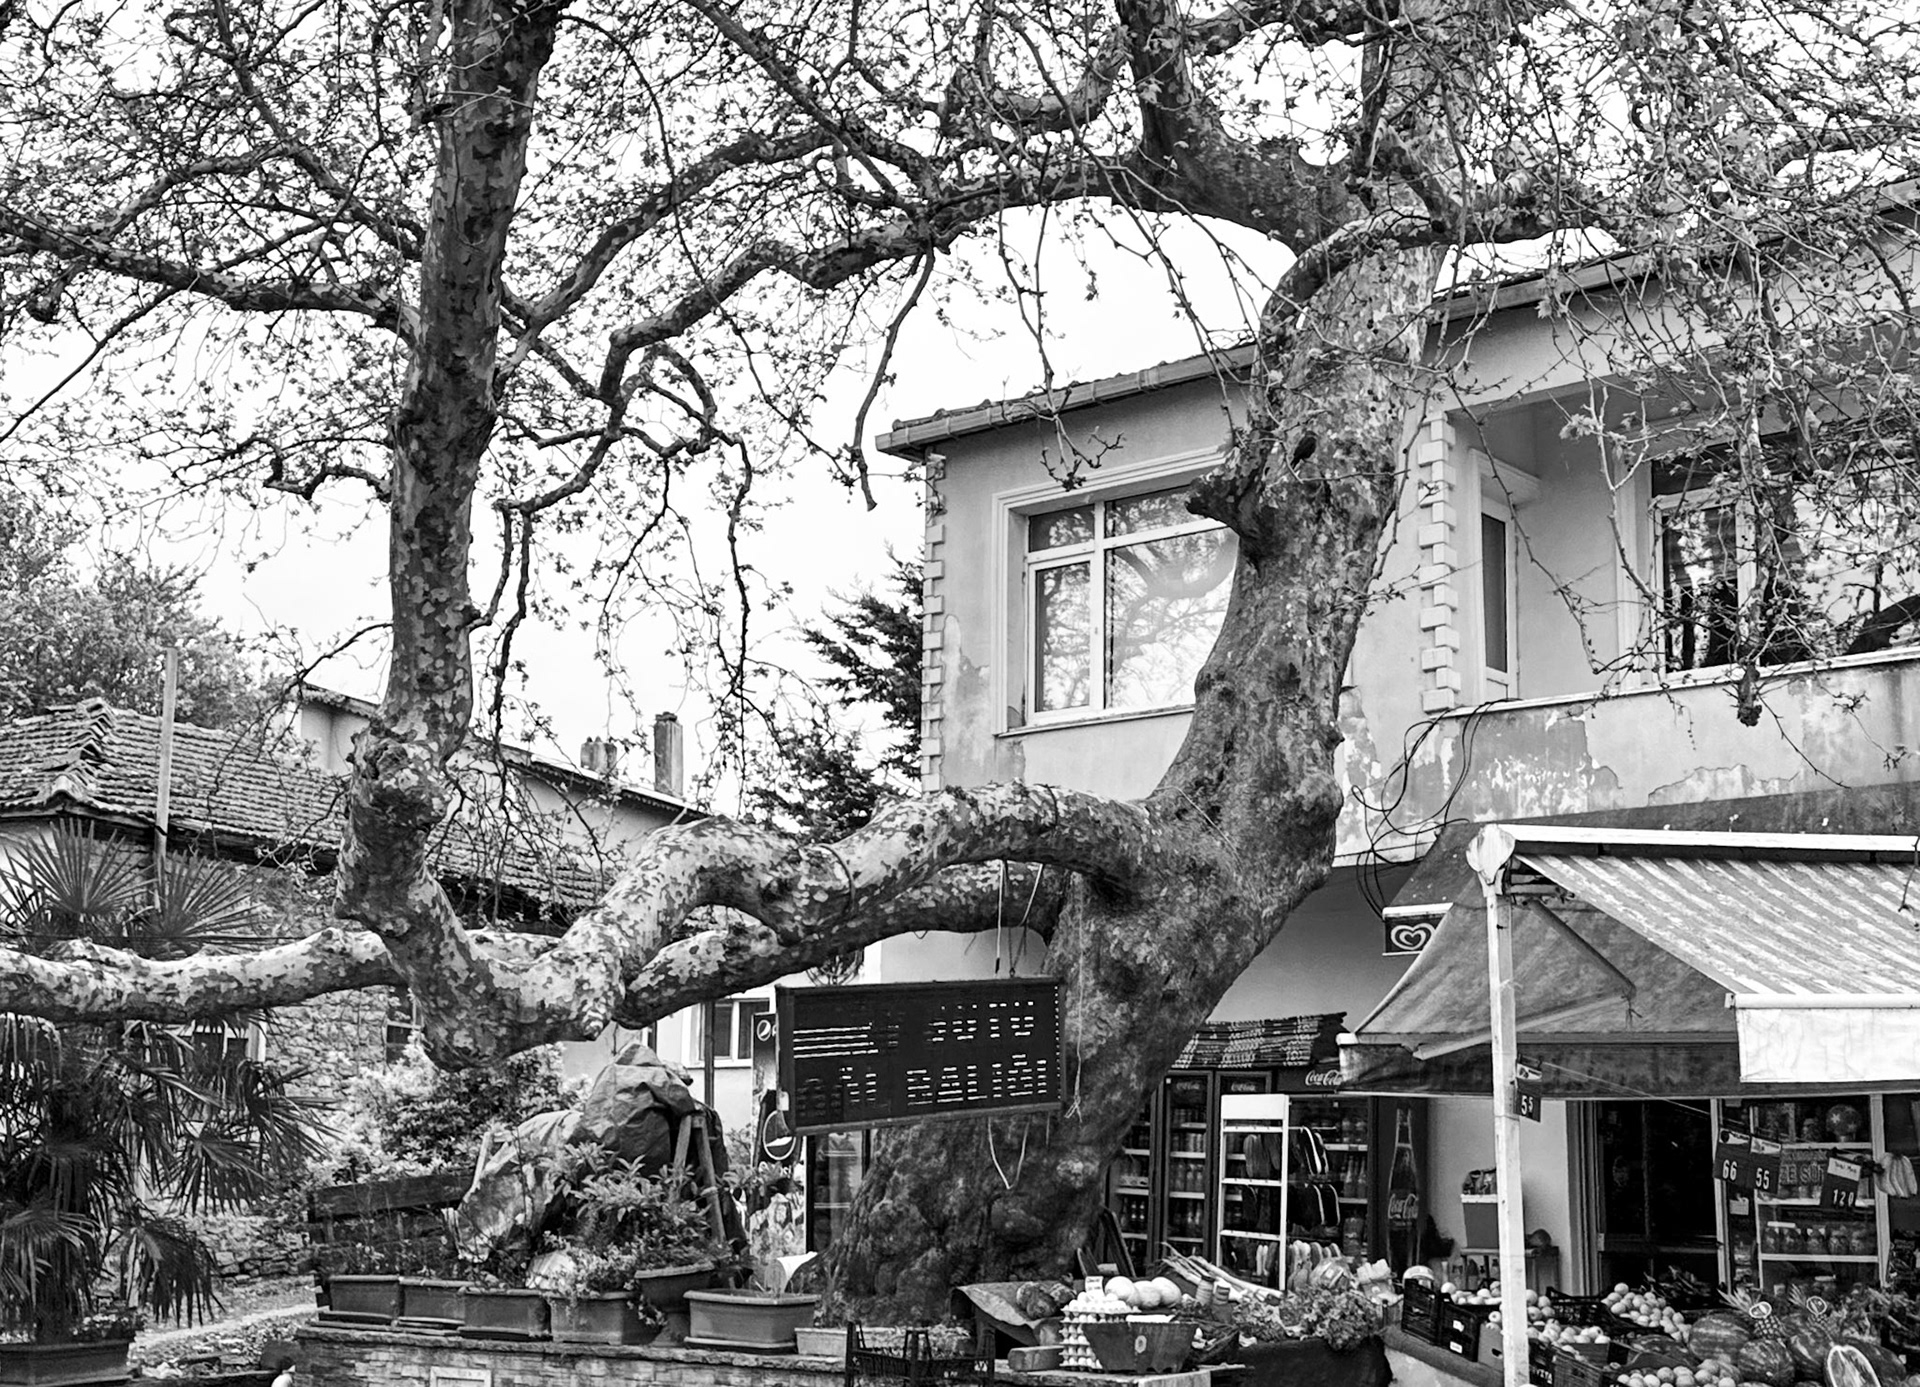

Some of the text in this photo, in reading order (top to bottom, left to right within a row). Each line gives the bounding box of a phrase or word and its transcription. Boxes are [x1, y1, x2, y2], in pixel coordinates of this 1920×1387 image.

[1520, 1095, 1534, 1115] 55
[1722, 1159, 1738, 1181] 66
[1755, 1167, 1770, 1190] 55
[1833, 1189, 1854, 1207] 120
